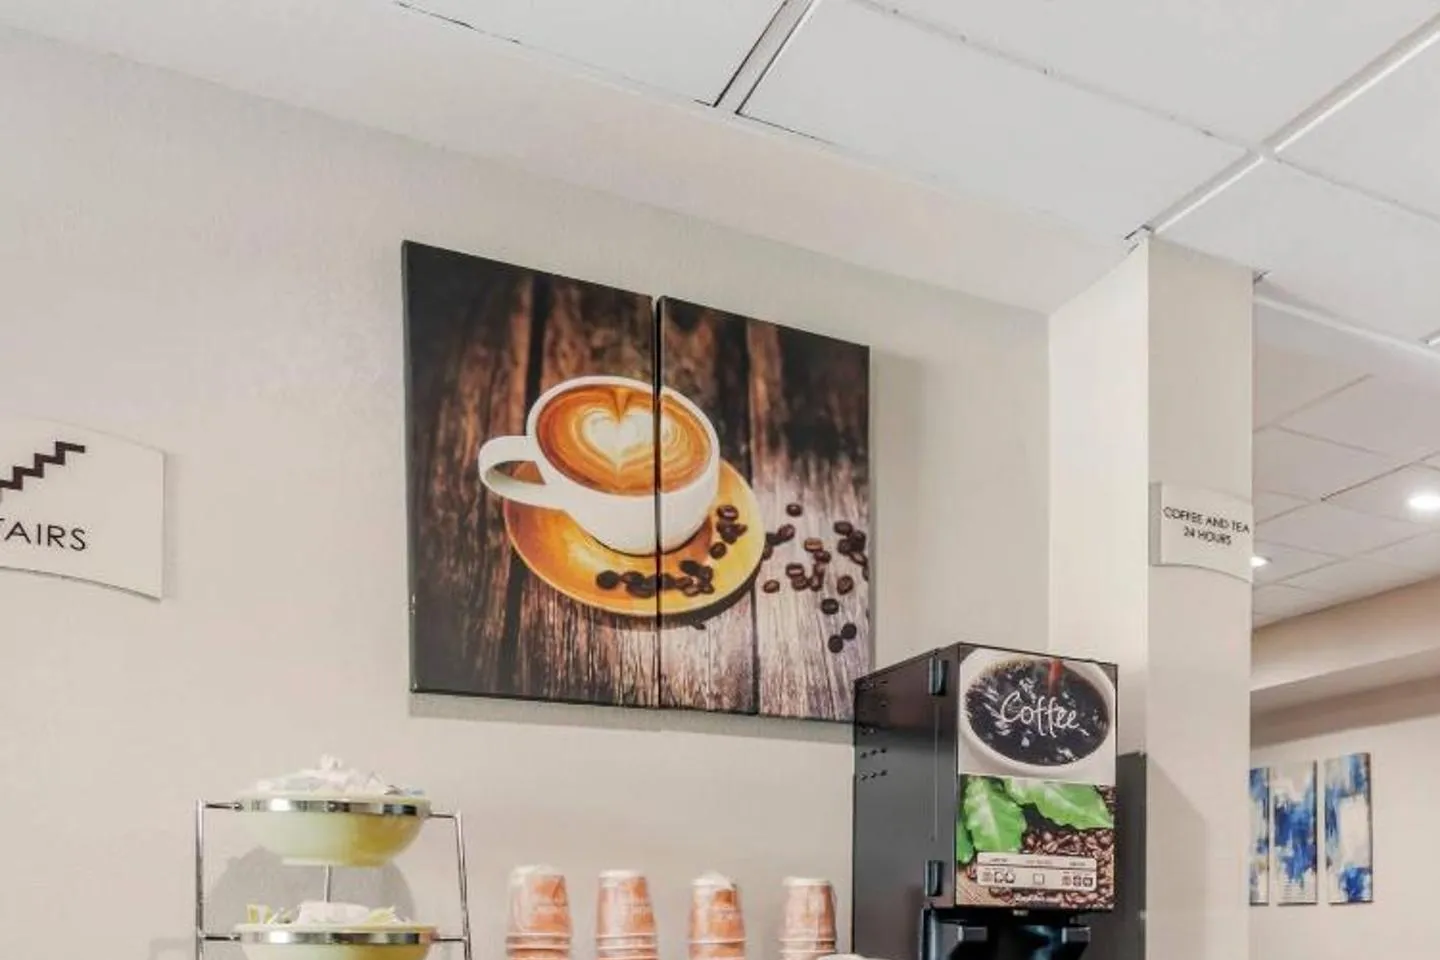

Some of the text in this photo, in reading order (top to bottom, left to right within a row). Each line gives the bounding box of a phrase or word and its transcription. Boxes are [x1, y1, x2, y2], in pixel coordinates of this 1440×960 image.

[1163, 506, 1251, 534] COFFEE AND TEA
[1183, 526, 1232, 546] 24 HOURS
[1000, 691, 1087, 738] Coffee
